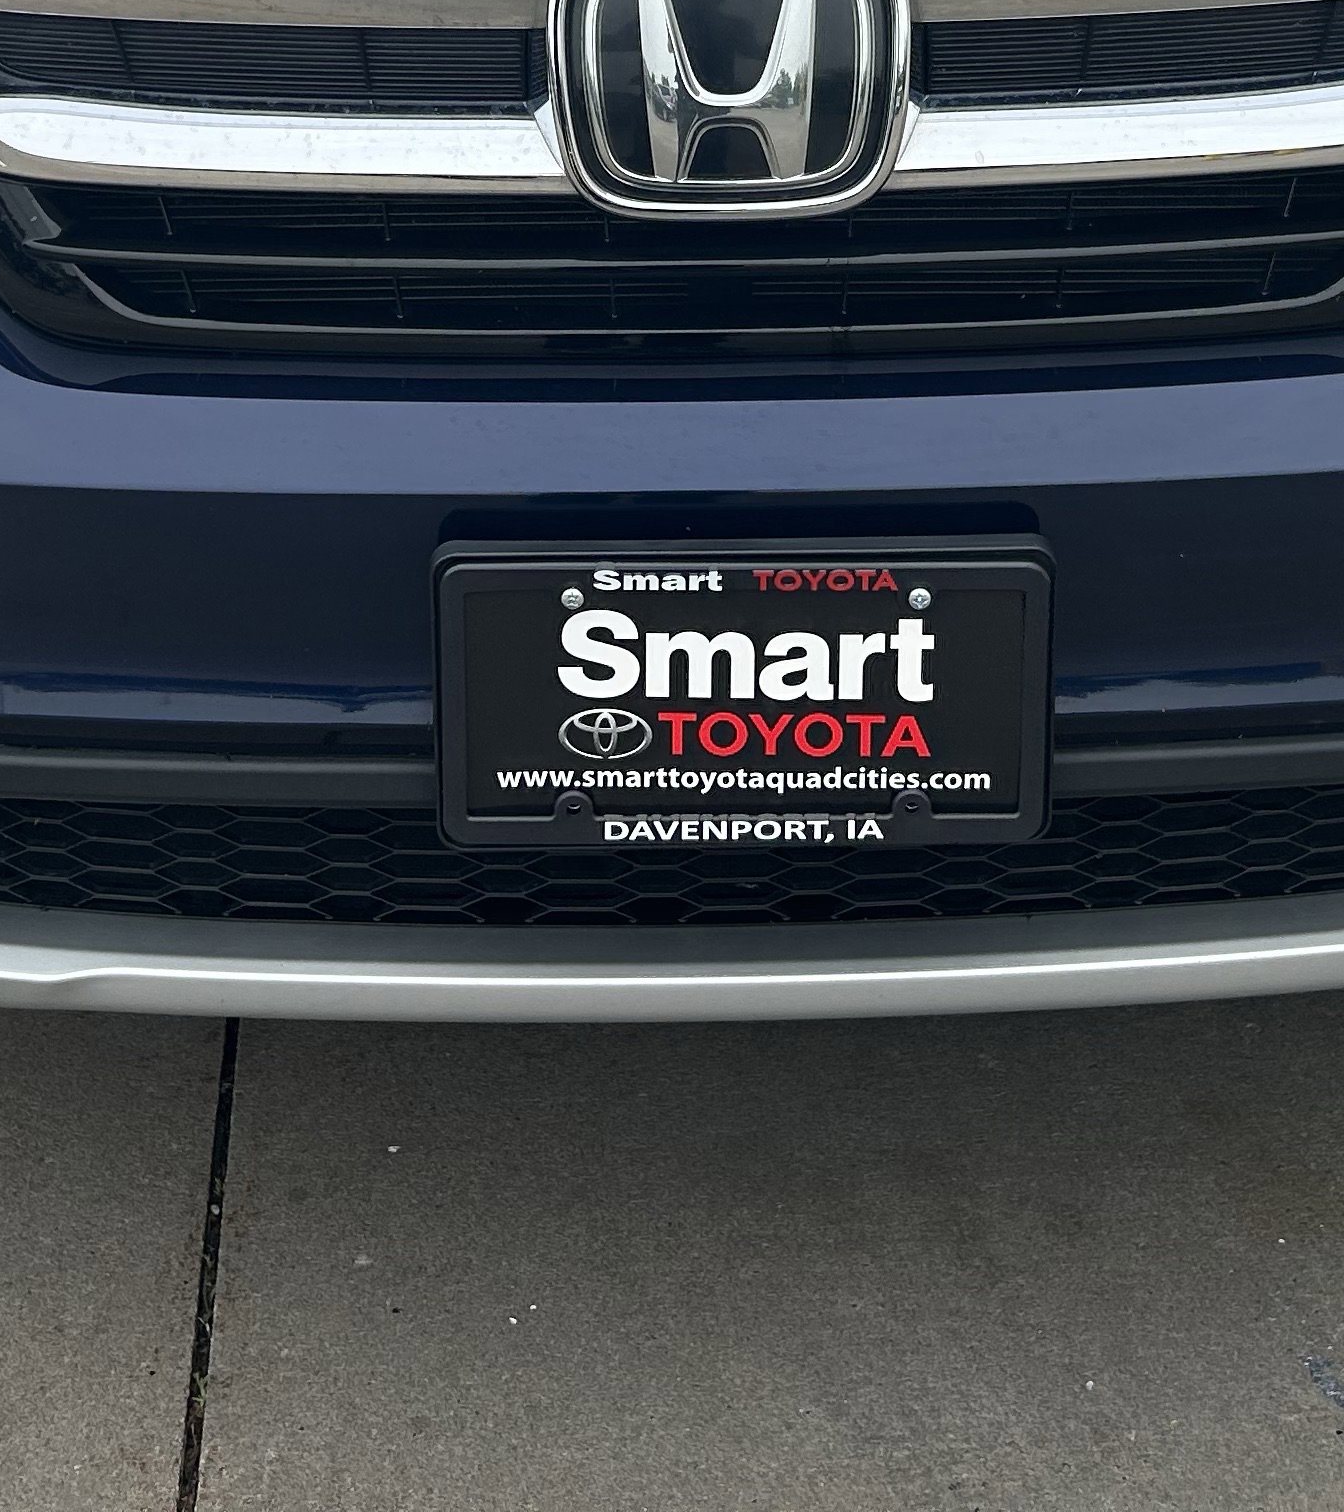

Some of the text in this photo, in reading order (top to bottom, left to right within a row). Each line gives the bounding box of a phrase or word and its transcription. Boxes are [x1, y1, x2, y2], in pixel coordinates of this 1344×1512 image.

[592, 568, 898, 592] Smart TOYOTA
[558, 609, 936, 702] Smart
[658, 712, 932, 758] TOYOTA
[497, 766, 992, 794] www.smarttoyotaquadcities.com
[602, 816, 885, 844] DAVENPORT, IA
